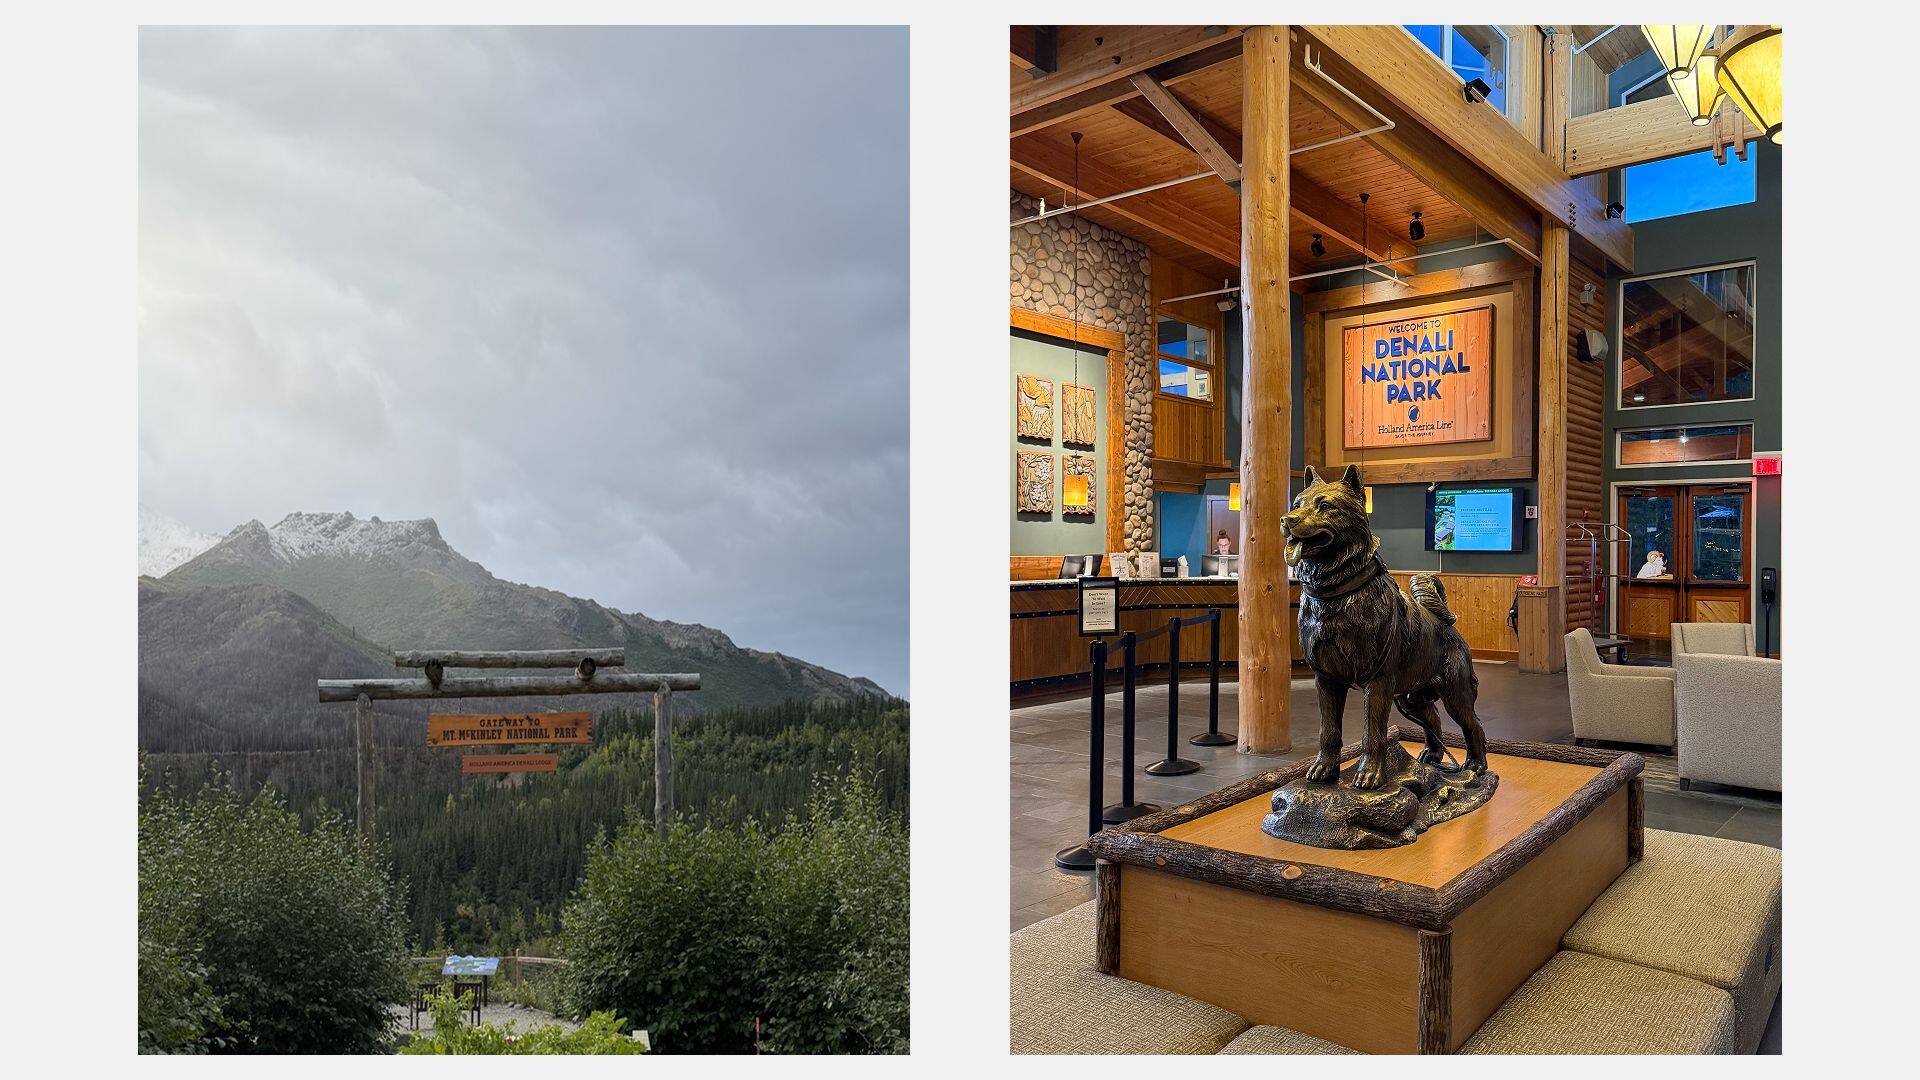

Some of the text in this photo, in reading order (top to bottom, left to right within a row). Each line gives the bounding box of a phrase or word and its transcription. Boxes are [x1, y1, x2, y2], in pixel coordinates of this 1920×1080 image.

[1388, 319, 1442, 334] WELCOME TO
[1375, 330, 1454, 359] DENALI
[1361, 351, 1471, 384] NATIONAL
[1386, 379, 1442, 404] PARK
[1378, 424, 1405, 434] Holland
[1406, 422, 1435, 432] America
[479, 717, 541, 728] GATEWAY TO
[442, 730, 457, 741] MT.
[506, 728, 550, 739] NATIONAL
[554, 727, 578, 738] PARK
